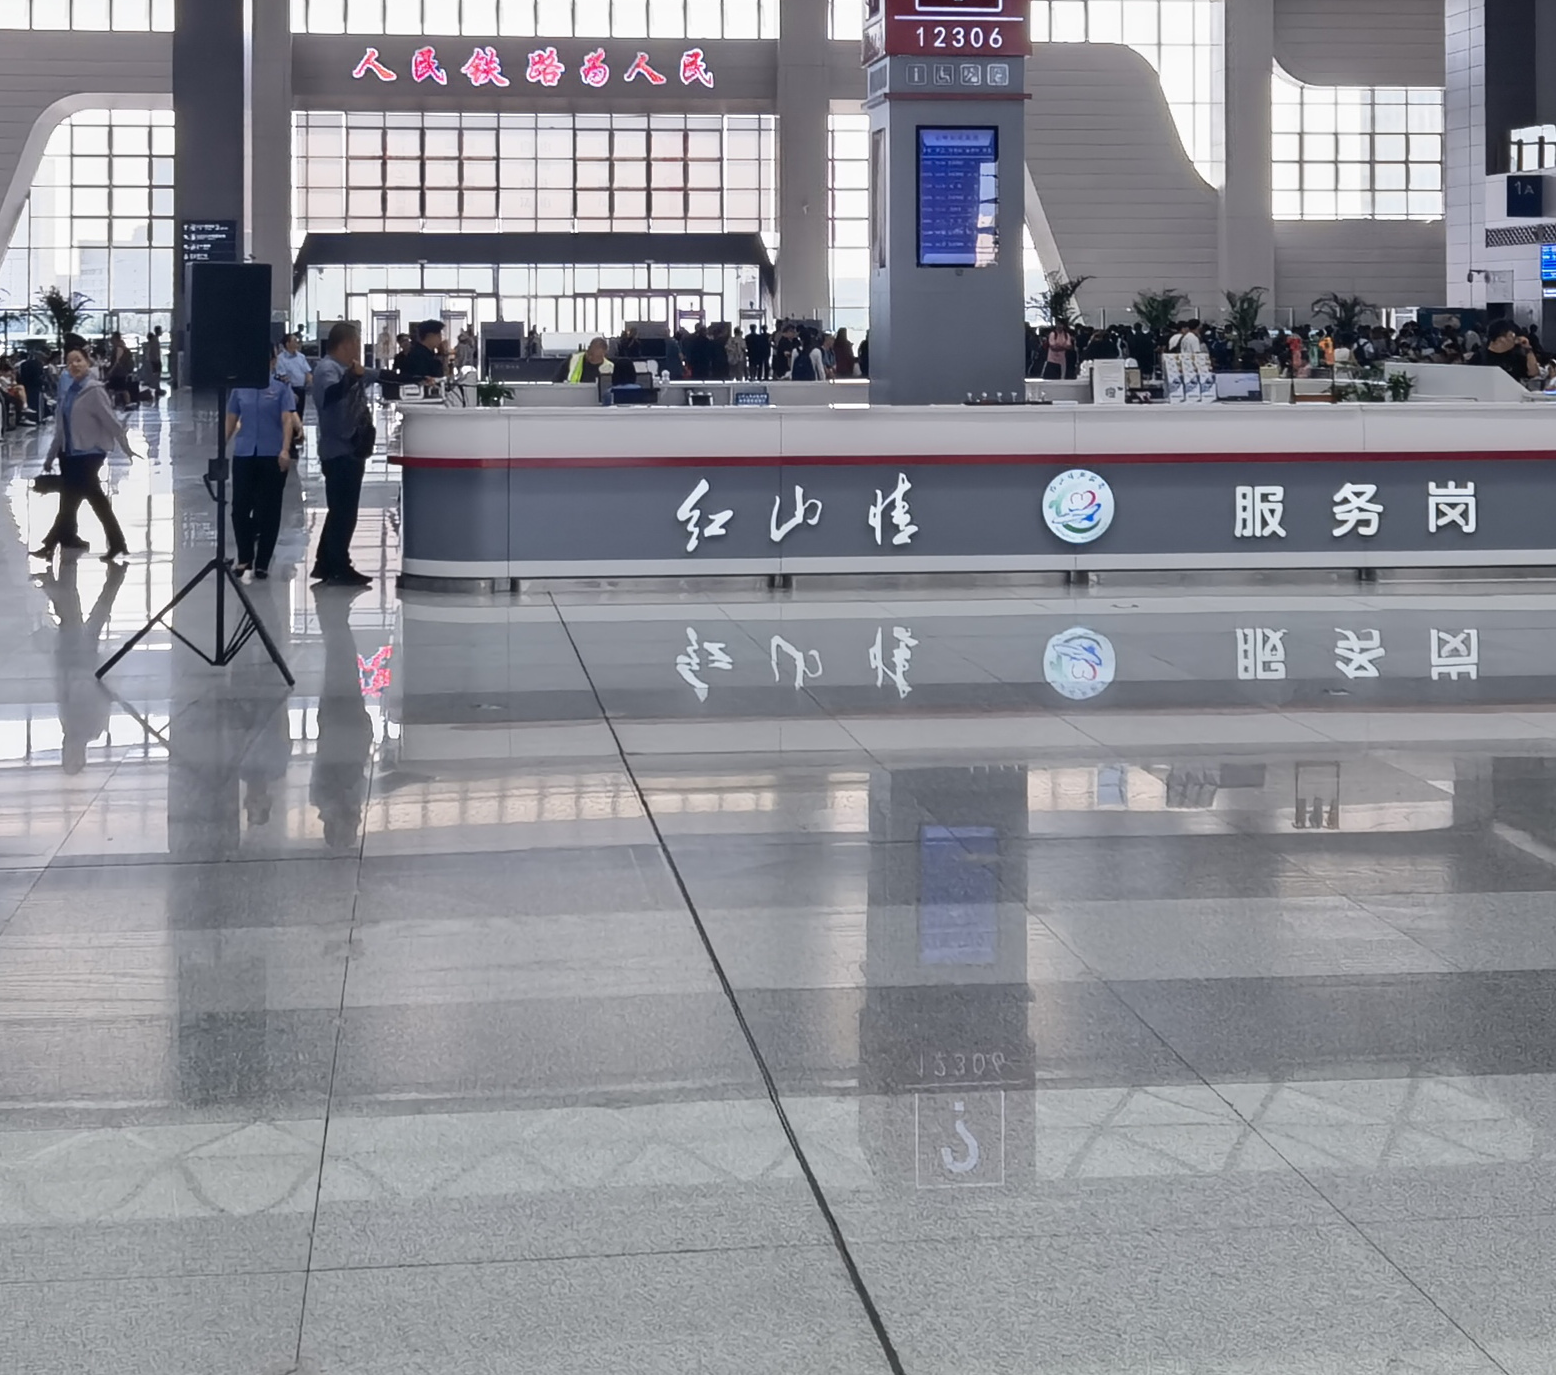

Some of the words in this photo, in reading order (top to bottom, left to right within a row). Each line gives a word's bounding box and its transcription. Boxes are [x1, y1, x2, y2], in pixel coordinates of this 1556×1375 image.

[916, 26, 1003, 49] 12306
[1514, 181, 1534, 195] 1A
[676, 473, 919, 552] 红山情
[1234, 481, 1476, 537] 服务岗
